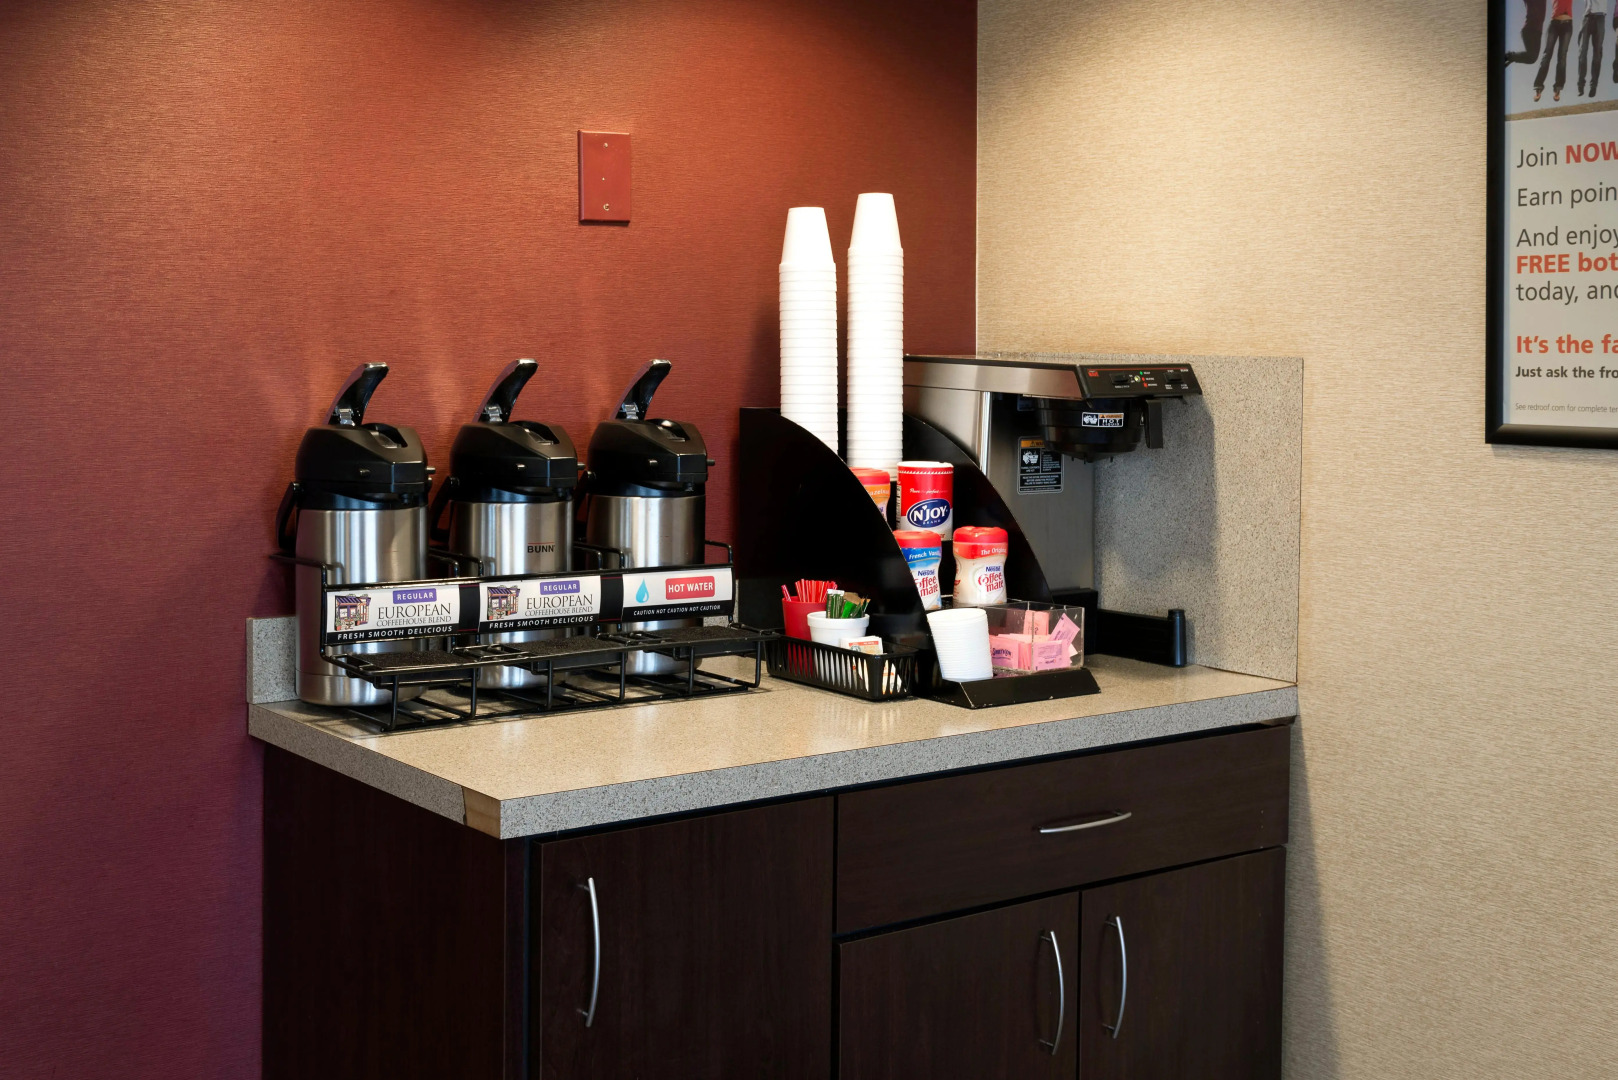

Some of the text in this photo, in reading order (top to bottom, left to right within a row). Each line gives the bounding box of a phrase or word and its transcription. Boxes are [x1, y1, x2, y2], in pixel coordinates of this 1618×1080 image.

[1516, 146, 1558, 168] Join
[1517, 187, 1562, 207] Earn
[1516, 225, 1559, 247] And
[1516, 253, 1570, 274] FREE
[1515, 280, 1579, 306] today,
[1516, 335, 1549, 354] It's
[1555, 333, 1594, 354] the
[1515, 365, 1542, 378] Just
[1545, 365, 1568, 378] ask
[1572, 365, 1595, 378] the
[1515, 402, 1526, 411] See
[1567, 403, 1576, 412] for
[1578, 404, 1608, 414] complete
[527, 544, 555, 553] BUNN
[908, 550, 927, 560] French
[980, 548, 990, 556] The
[543, 583, 577, 592] REGULAR
[668, 582, 714, 593] HOT WATER
[396, 591, 434, 600] REGULAR
[526, 594, 593, 610] EUROPEAN
[377, 602, 451, 620] EUROPEAN
[524, 606, 593, 617] COFFEEHOUSE BLEND
[376, 615, 452, 627] COFFEEHOUSE BLEND
[489, 615, 594, 629] FRESH SMOOTH DELICIOUS
[337, 625, 453, 640] FRESH SMOOTH DELICIOUS
